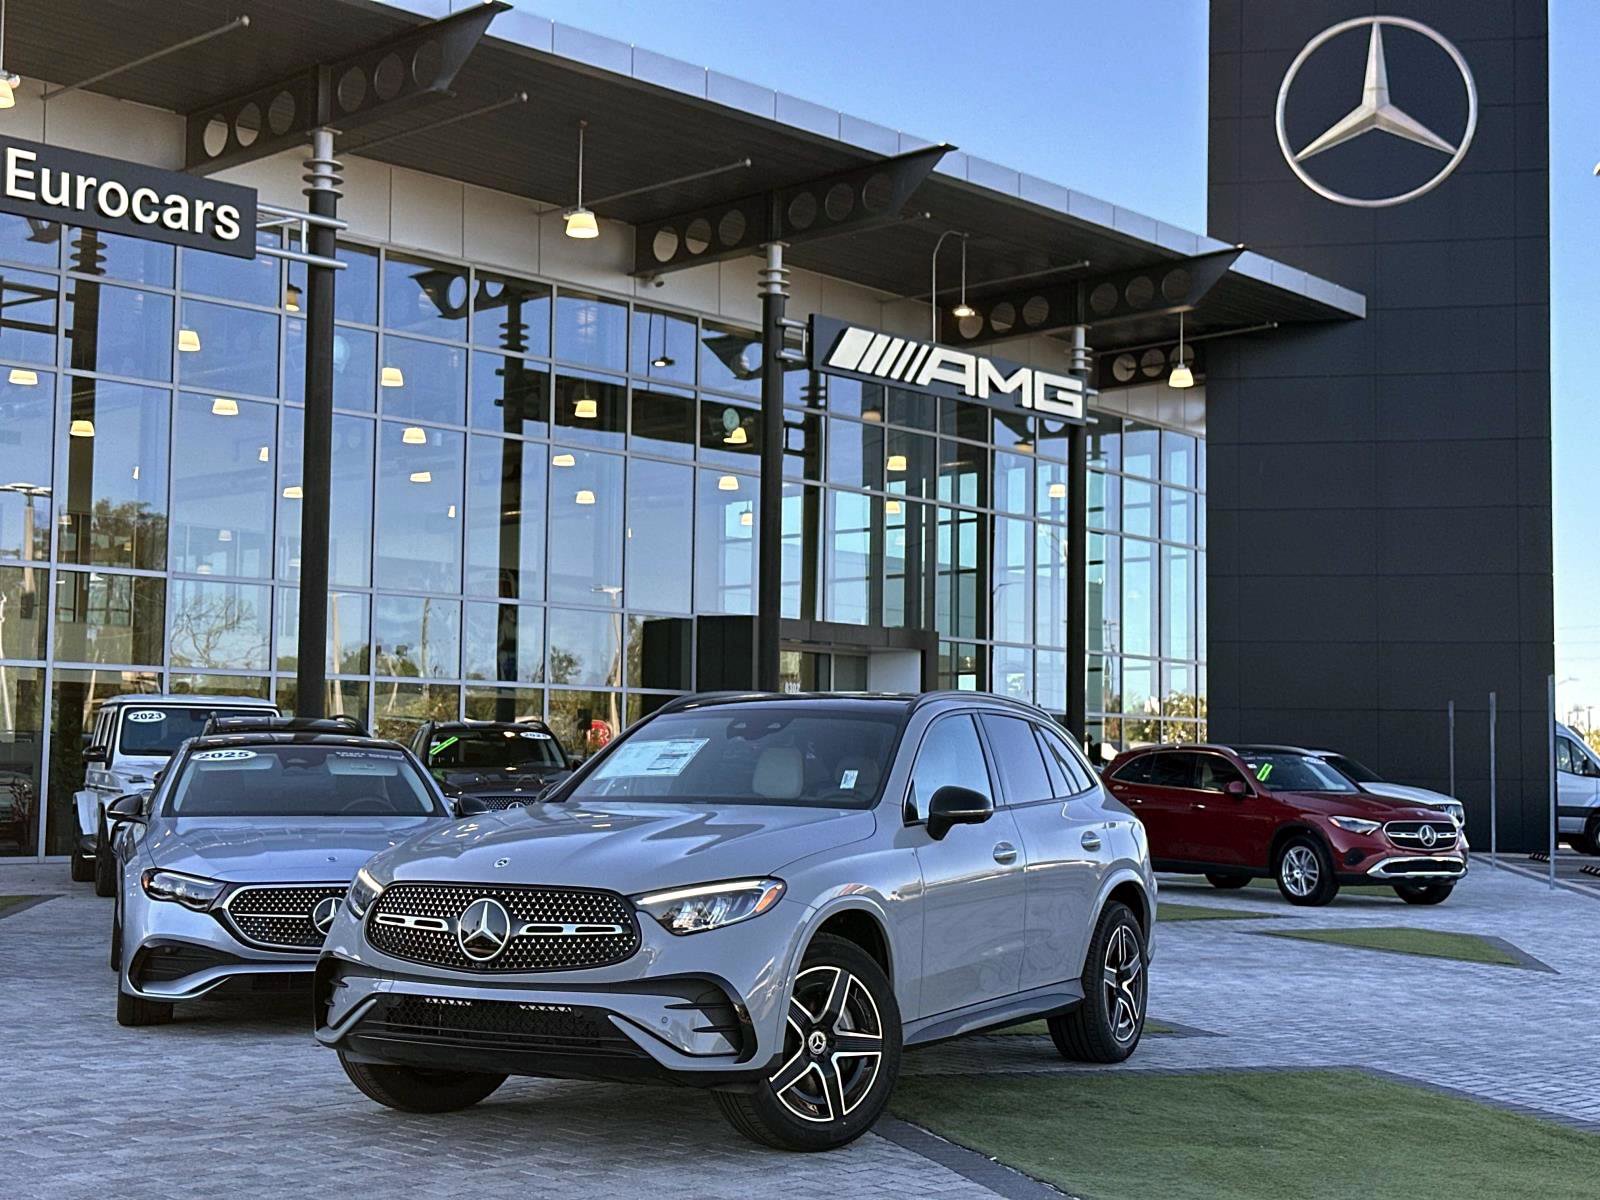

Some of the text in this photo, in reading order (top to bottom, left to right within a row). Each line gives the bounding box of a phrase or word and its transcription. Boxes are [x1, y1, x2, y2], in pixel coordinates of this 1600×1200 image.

[5, 146, 240, 241] Eurocars
[914, 346, 1083, 419] AMG
[132, 712, 163, 720] 2023
[197, 751, 250, 760] 2025
